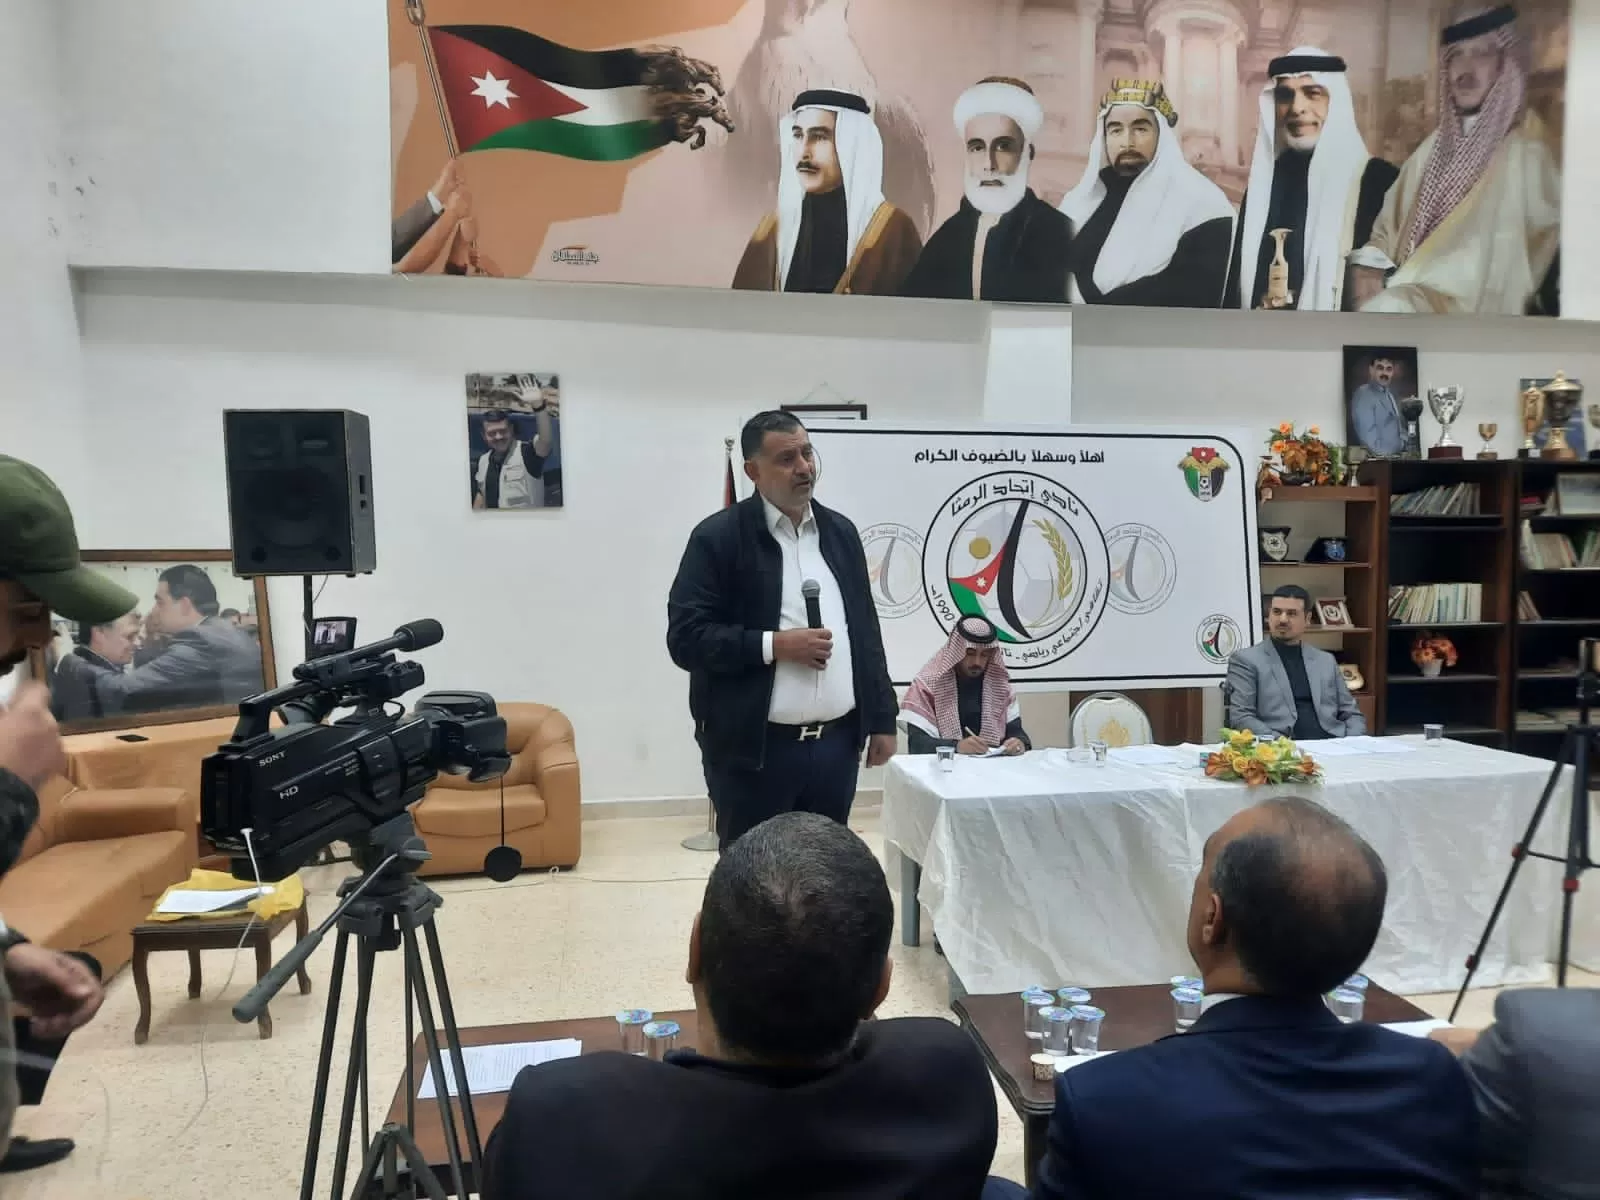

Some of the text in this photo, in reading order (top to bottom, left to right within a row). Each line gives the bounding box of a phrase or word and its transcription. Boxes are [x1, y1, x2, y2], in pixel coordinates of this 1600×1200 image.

[914, 448, 958, 464] الكرام
[961, 449, 1026, 464] بالضيوف
[951, 483, 987, 517] الرمثا
[1041, 489, 1079, 516] نادي
[258, 751, 286, 768] SONY
[279, 785, 300, 800] HD
